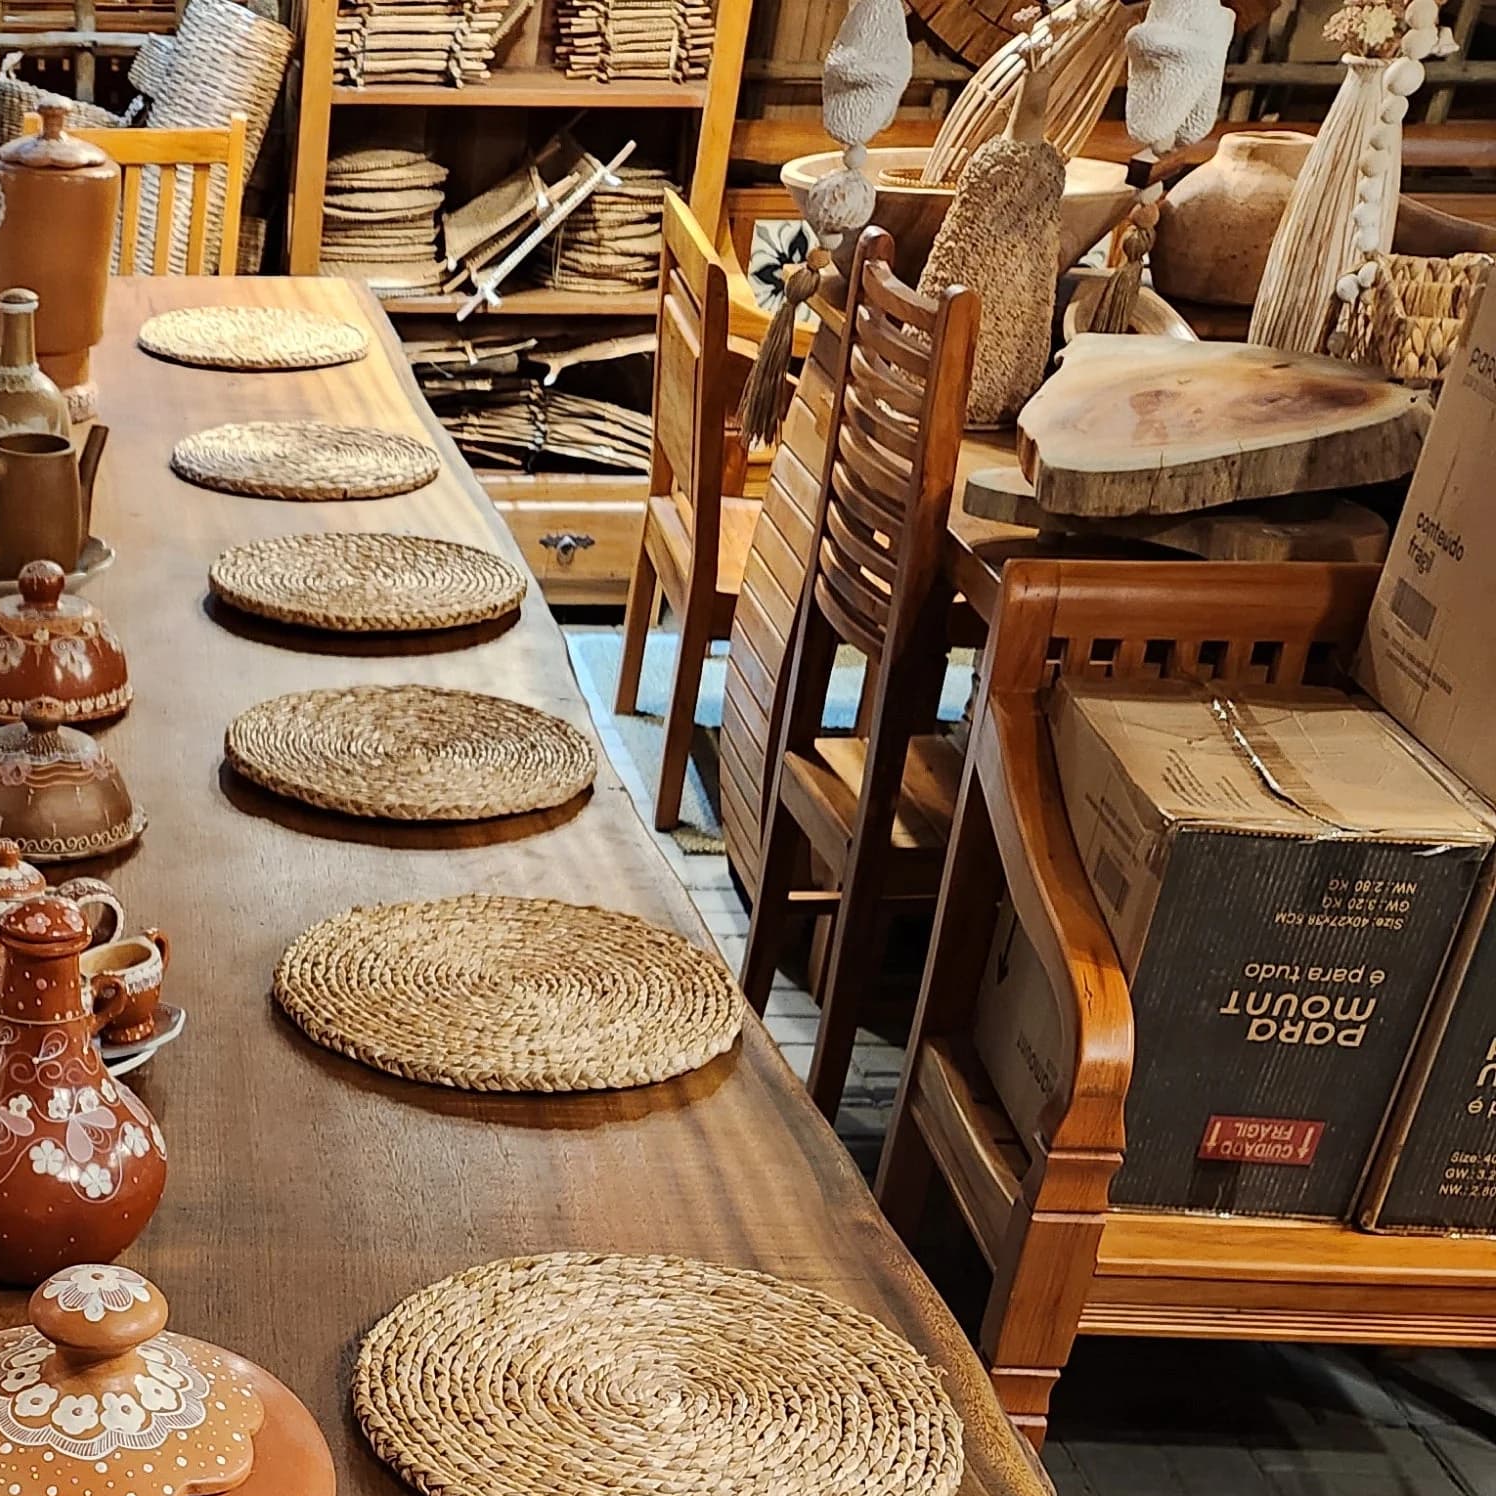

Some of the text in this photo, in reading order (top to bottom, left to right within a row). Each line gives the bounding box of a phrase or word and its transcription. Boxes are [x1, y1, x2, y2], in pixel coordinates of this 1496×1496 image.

[1327, 879, 1349, 891] KG
[1348, 898, 1377, 910] 3.20
[1244, 963, 1386, 989] é para tudo
[1467, 1096, 1484, 1114] é
[1234, 1122, 1295, 1142] FRÁGIL
[1220, 1140, 1294, 1159] CUIDADO
